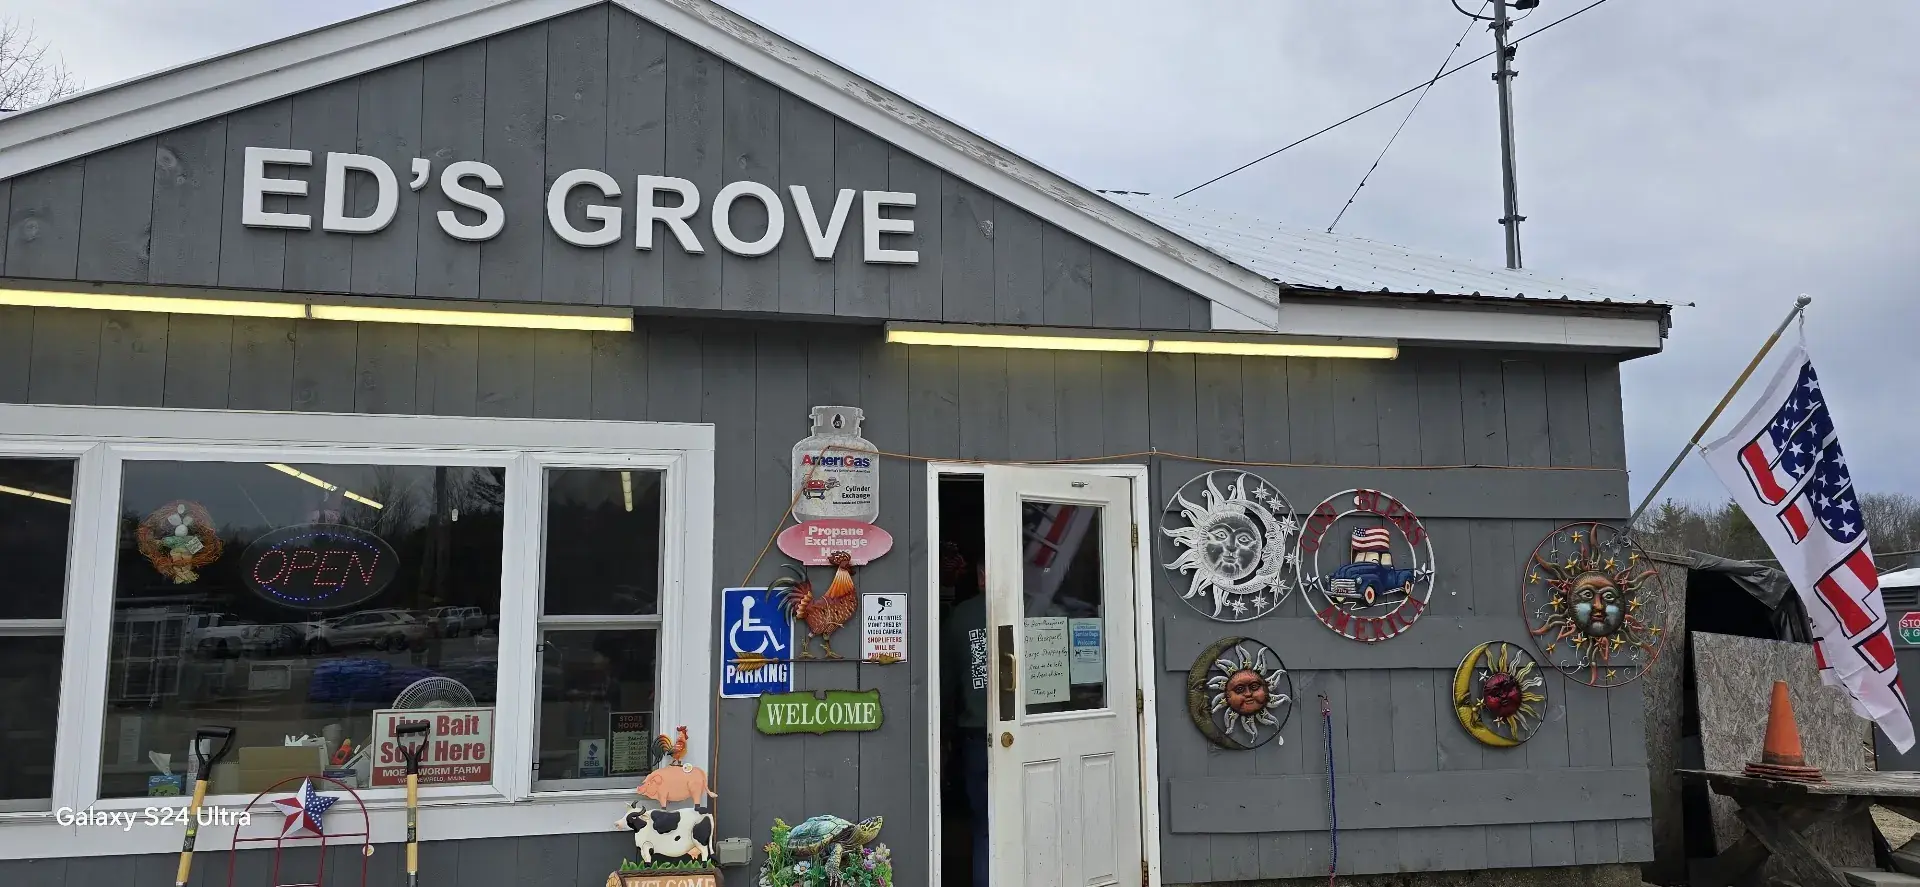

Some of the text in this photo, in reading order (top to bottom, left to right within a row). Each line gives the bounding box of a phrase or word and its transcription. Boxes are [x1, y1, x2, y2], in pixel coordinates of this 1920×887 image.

[241, 146, 920, 266] ED'S GROVE
[801, 454, 871, 468] AmeriGas
[841, 492, 871, 500] Exchange
[845, 485, 871, 493] Cylinder
[808, 525, 864, 537] Propane
[1299, 488, 1427, 553] GOD BLESS
[804, 536, 868, 548] Exchange
[253, 549, 381, 586] OPEN
[1317, 594, 1427, 642] AMERICA
[726, 663, 788, 684] PARKING
[766, 702, 876, 726] WELCOME
[435, 714, 480, 737] Bait
[380, 740, 486, 764] Sold Here
[382, 765, 481, 777] MOE' WORM FARM
